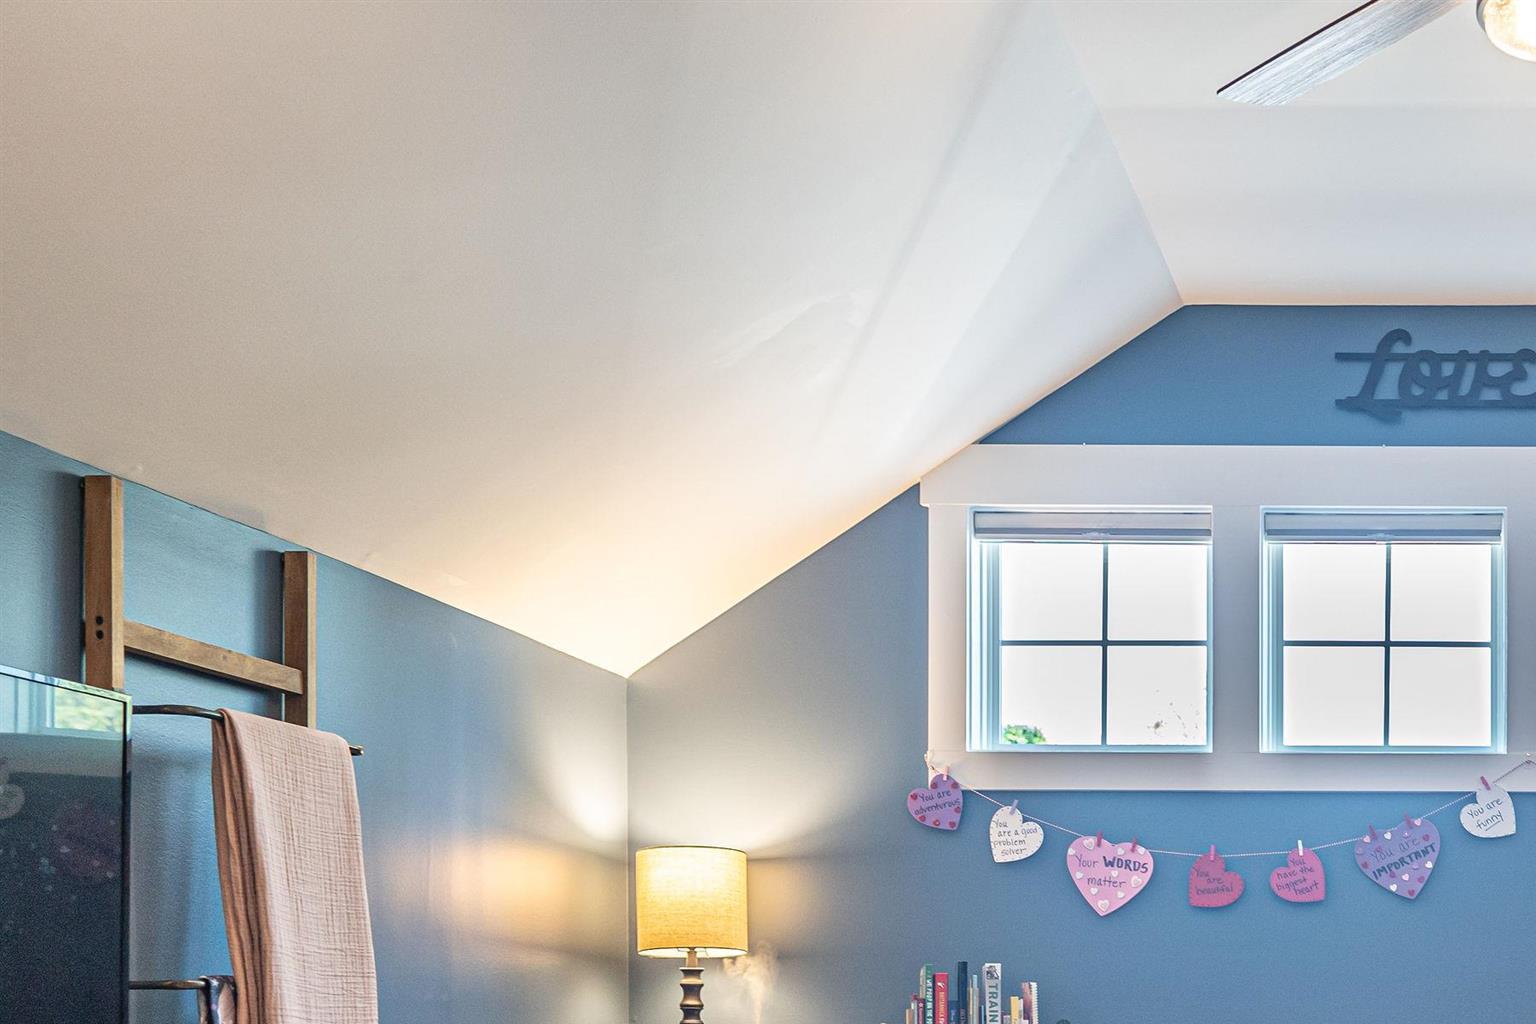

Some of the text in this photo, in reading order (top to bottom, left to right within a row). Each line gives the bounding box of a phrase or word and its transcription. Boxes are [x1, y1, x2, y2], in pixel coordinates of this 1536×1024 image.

[919, 790, 952, 801] You are
[1467, 799, 1503, 819] You are
[992, 820, 1008, 828] You
[1476, 810, 1504, 829] funny
[1021, 828, 1038, 838] good
[993, 839, 1026, 848] problem
[1001, 848, 1027, 856] solver
[1370, 848, 1393, 861] You
[1075, 854, 1149, 873] Your WORDS
[1372, 843, 1436, 880] IMPORTANT
[1087, 877, 1126, 888] matter
[988, 983, 999, 1023] TRAIN
